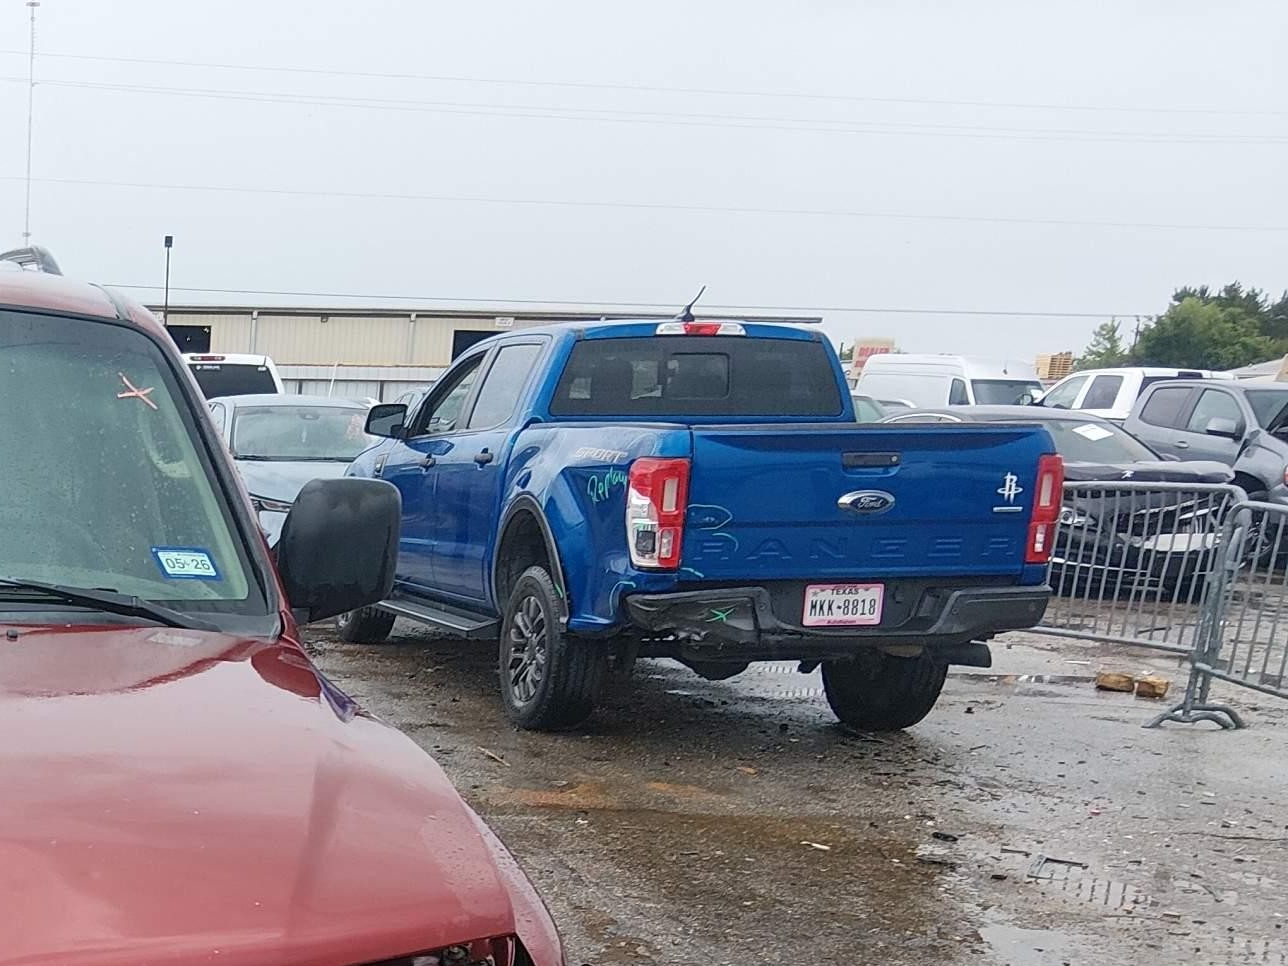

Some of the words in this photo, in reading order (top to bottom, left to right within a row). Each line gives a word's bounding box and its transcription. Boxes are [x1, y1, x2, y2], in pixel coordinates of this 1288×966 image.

[575, 447, 629, 465] SPORT
[692, 536, 1017, 561] RANGER
[831, 588, 860, 596] TEXAS
